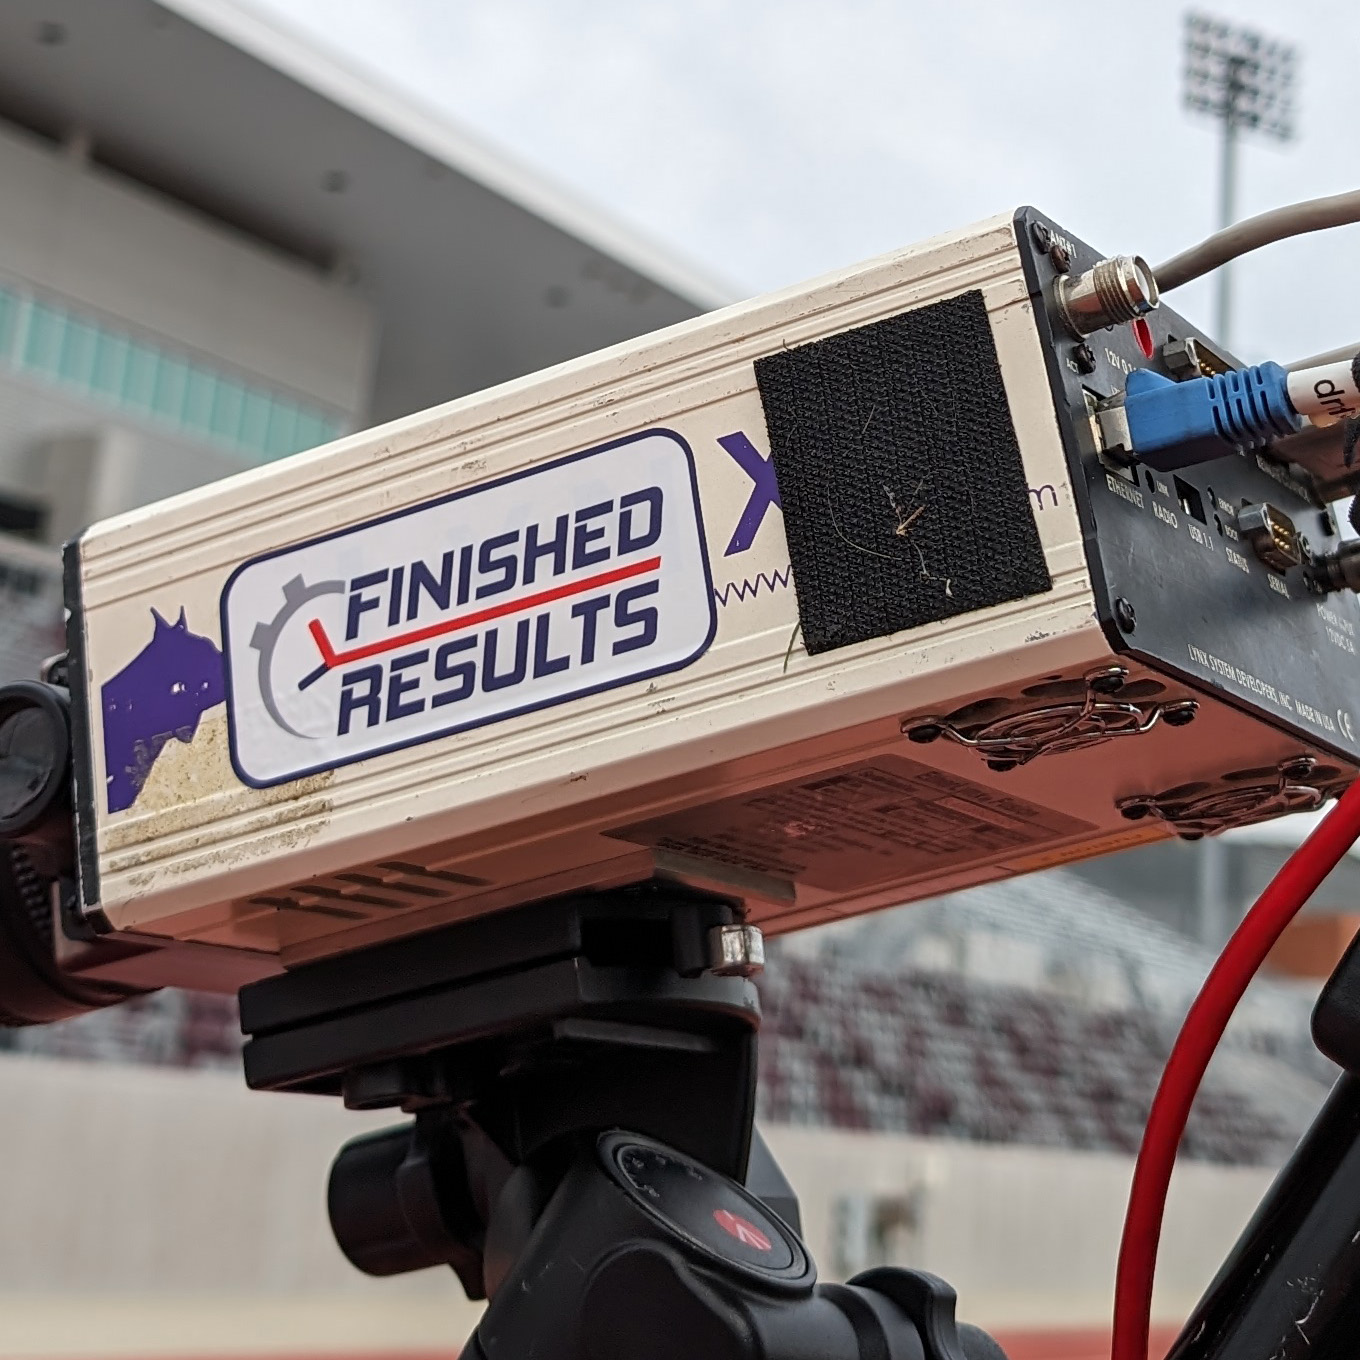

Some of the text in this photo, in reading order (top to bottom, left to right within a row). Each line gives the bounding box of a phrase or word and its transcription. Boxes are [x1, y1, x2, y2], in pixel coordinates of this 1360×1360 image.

[1106, 473, 1145, 509] ETHERNET
[1152, 500, 1178, 529] RADIO
[345, 485, 663, 641] FINISHED
[1266, 573, 1290, 600] SERIAL
[337, 578, 659, 737] RESULTS
[1187, 643, 1211, 669] LYNX
[1208, 653, 1238, 682] SYSTEM
